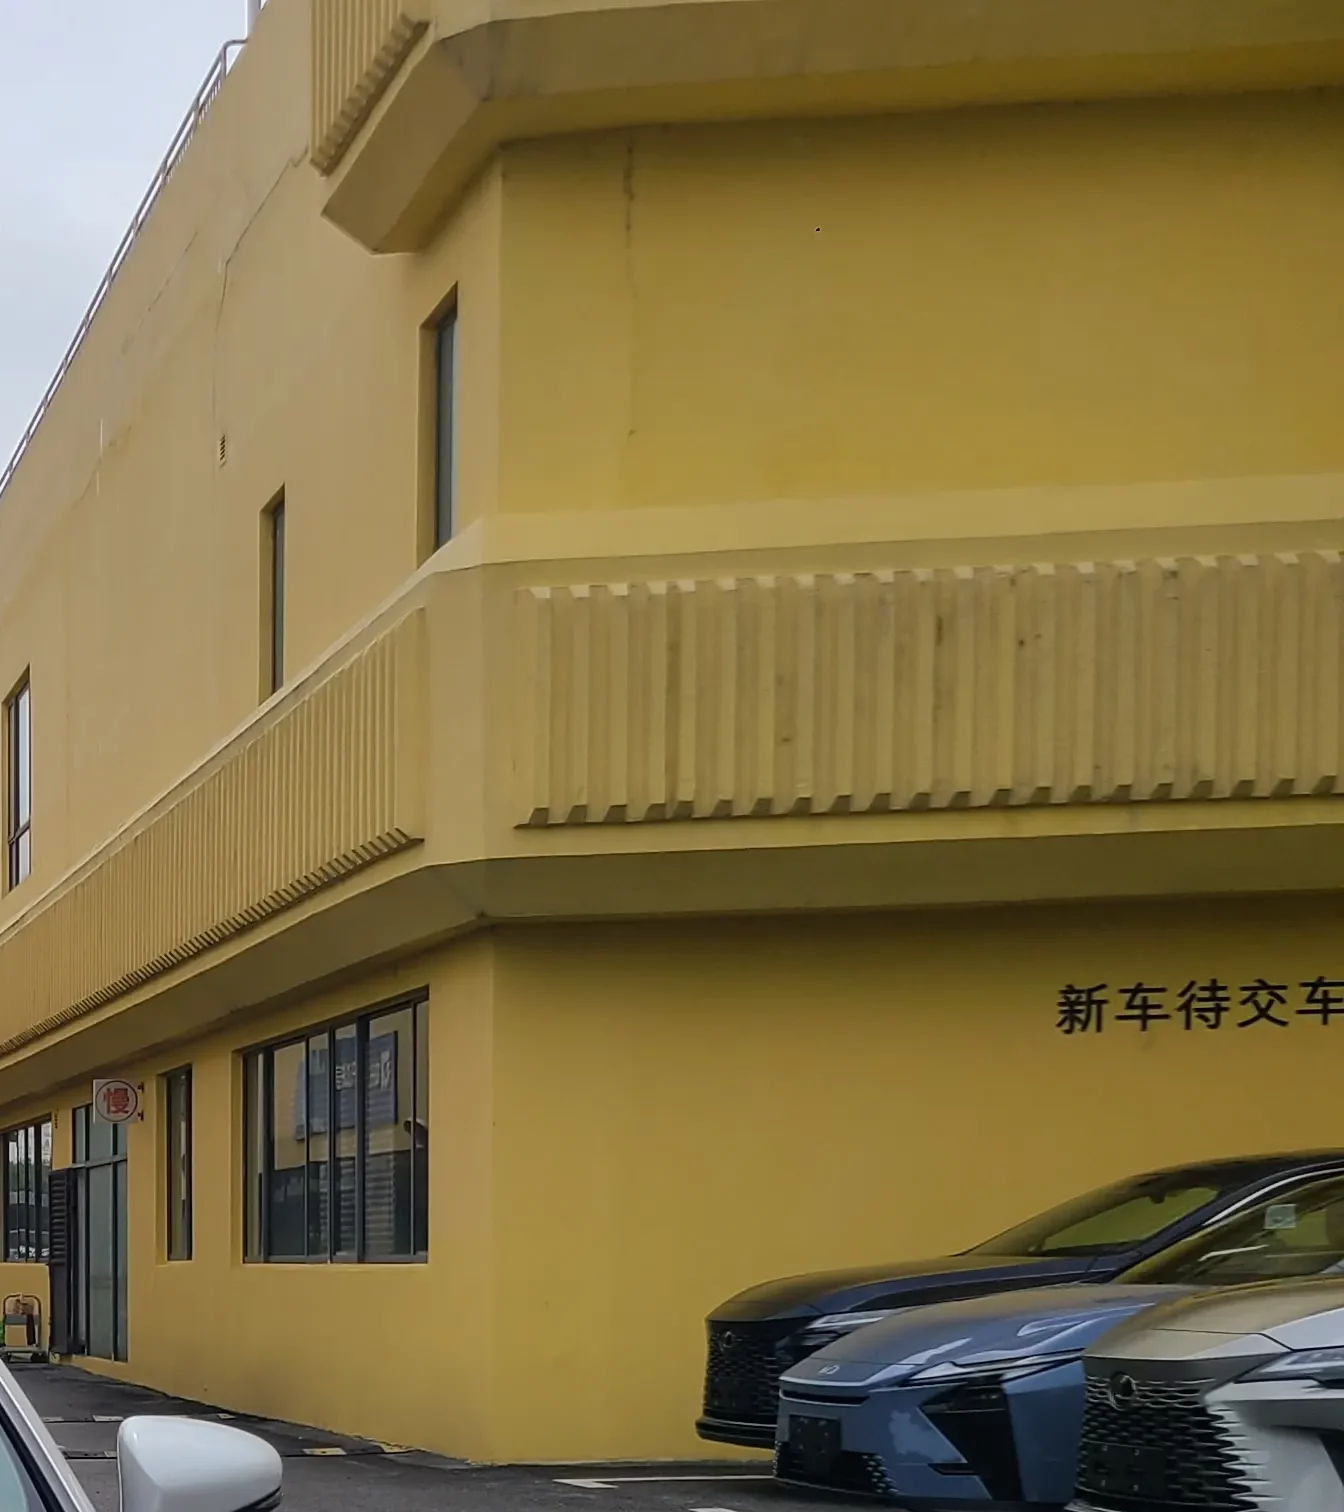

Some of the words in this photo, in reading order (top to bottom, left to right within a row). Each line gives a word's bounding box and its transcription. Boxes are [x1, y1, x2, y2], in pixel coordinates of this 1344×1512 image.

[1055, 976, 1344, 1035] 新车待交车
